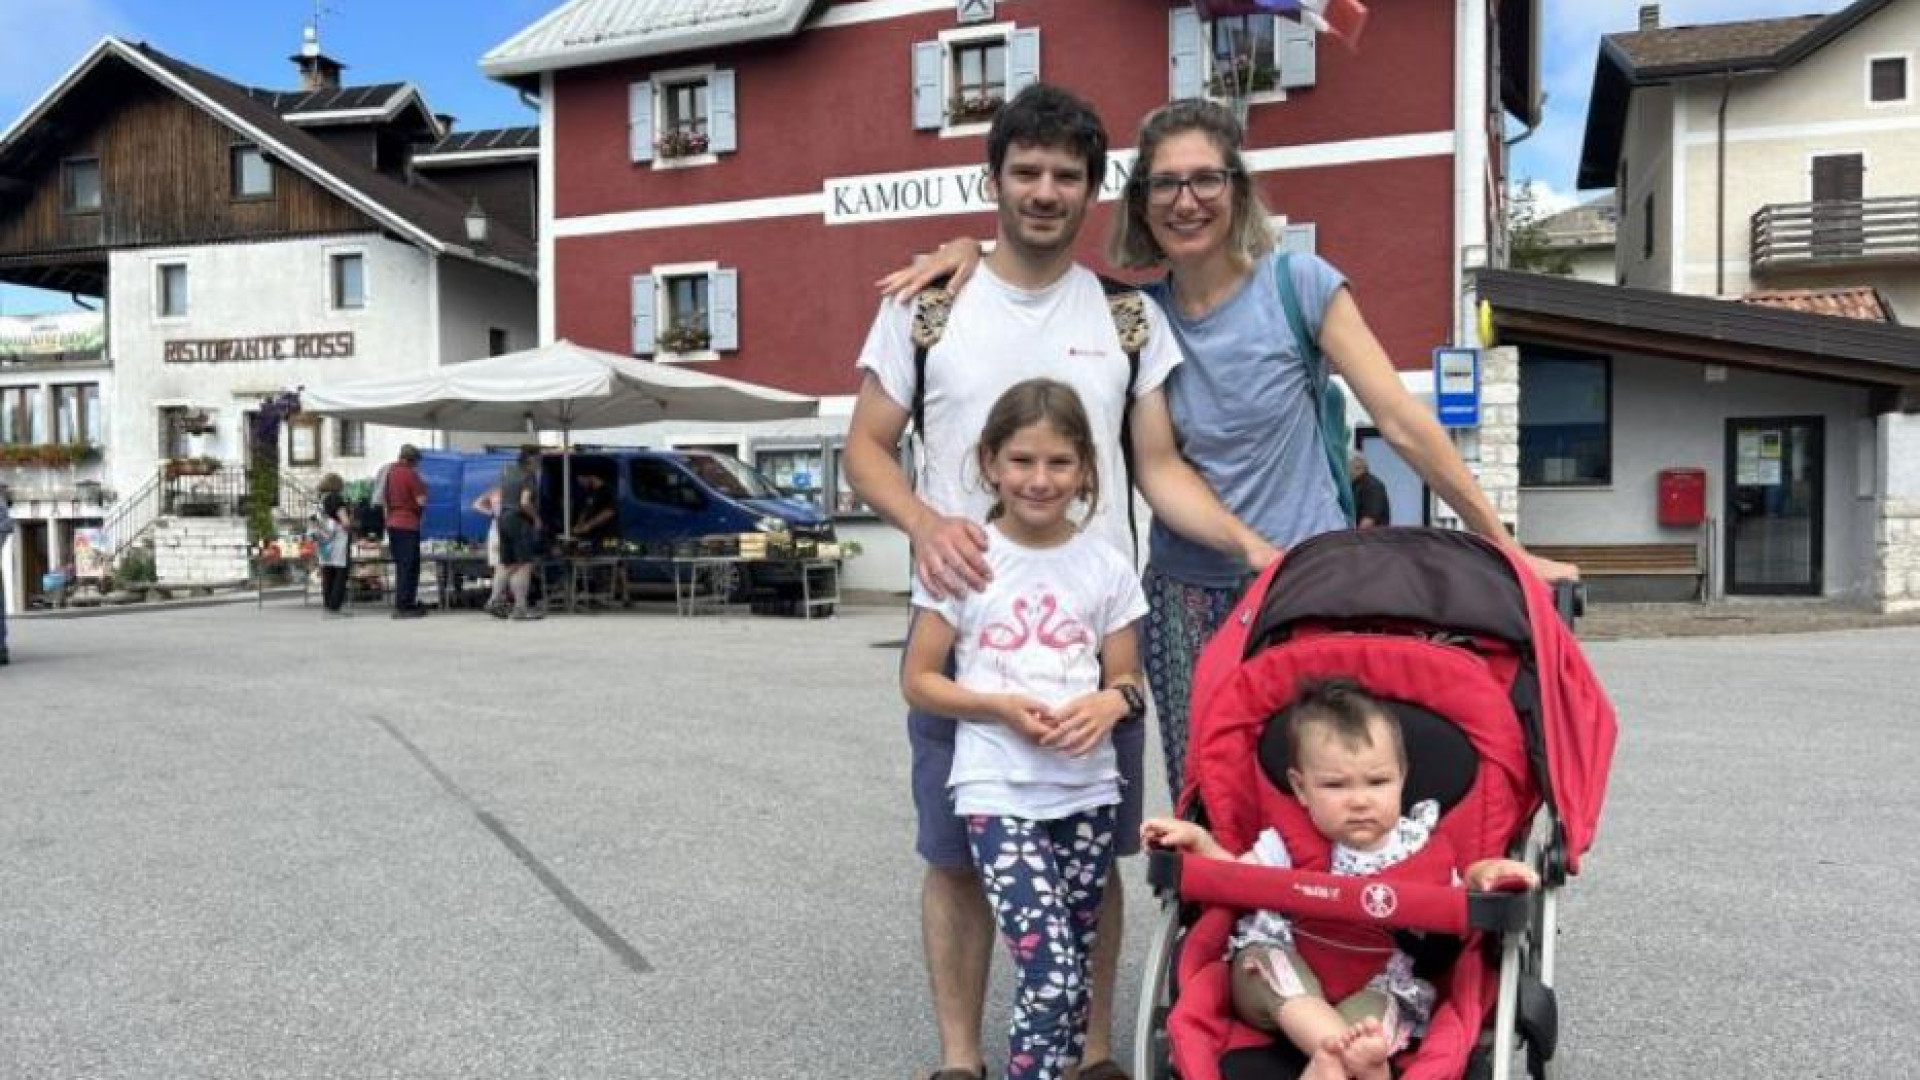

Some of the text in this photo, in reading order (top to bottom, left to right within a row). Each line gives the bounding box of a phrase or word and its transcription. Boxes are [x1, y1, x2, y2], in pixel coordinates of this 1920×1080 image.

[833, 176, 944, 216] KAMOU
[164, 331, 355, 364] RISTORANTE ROSSI
